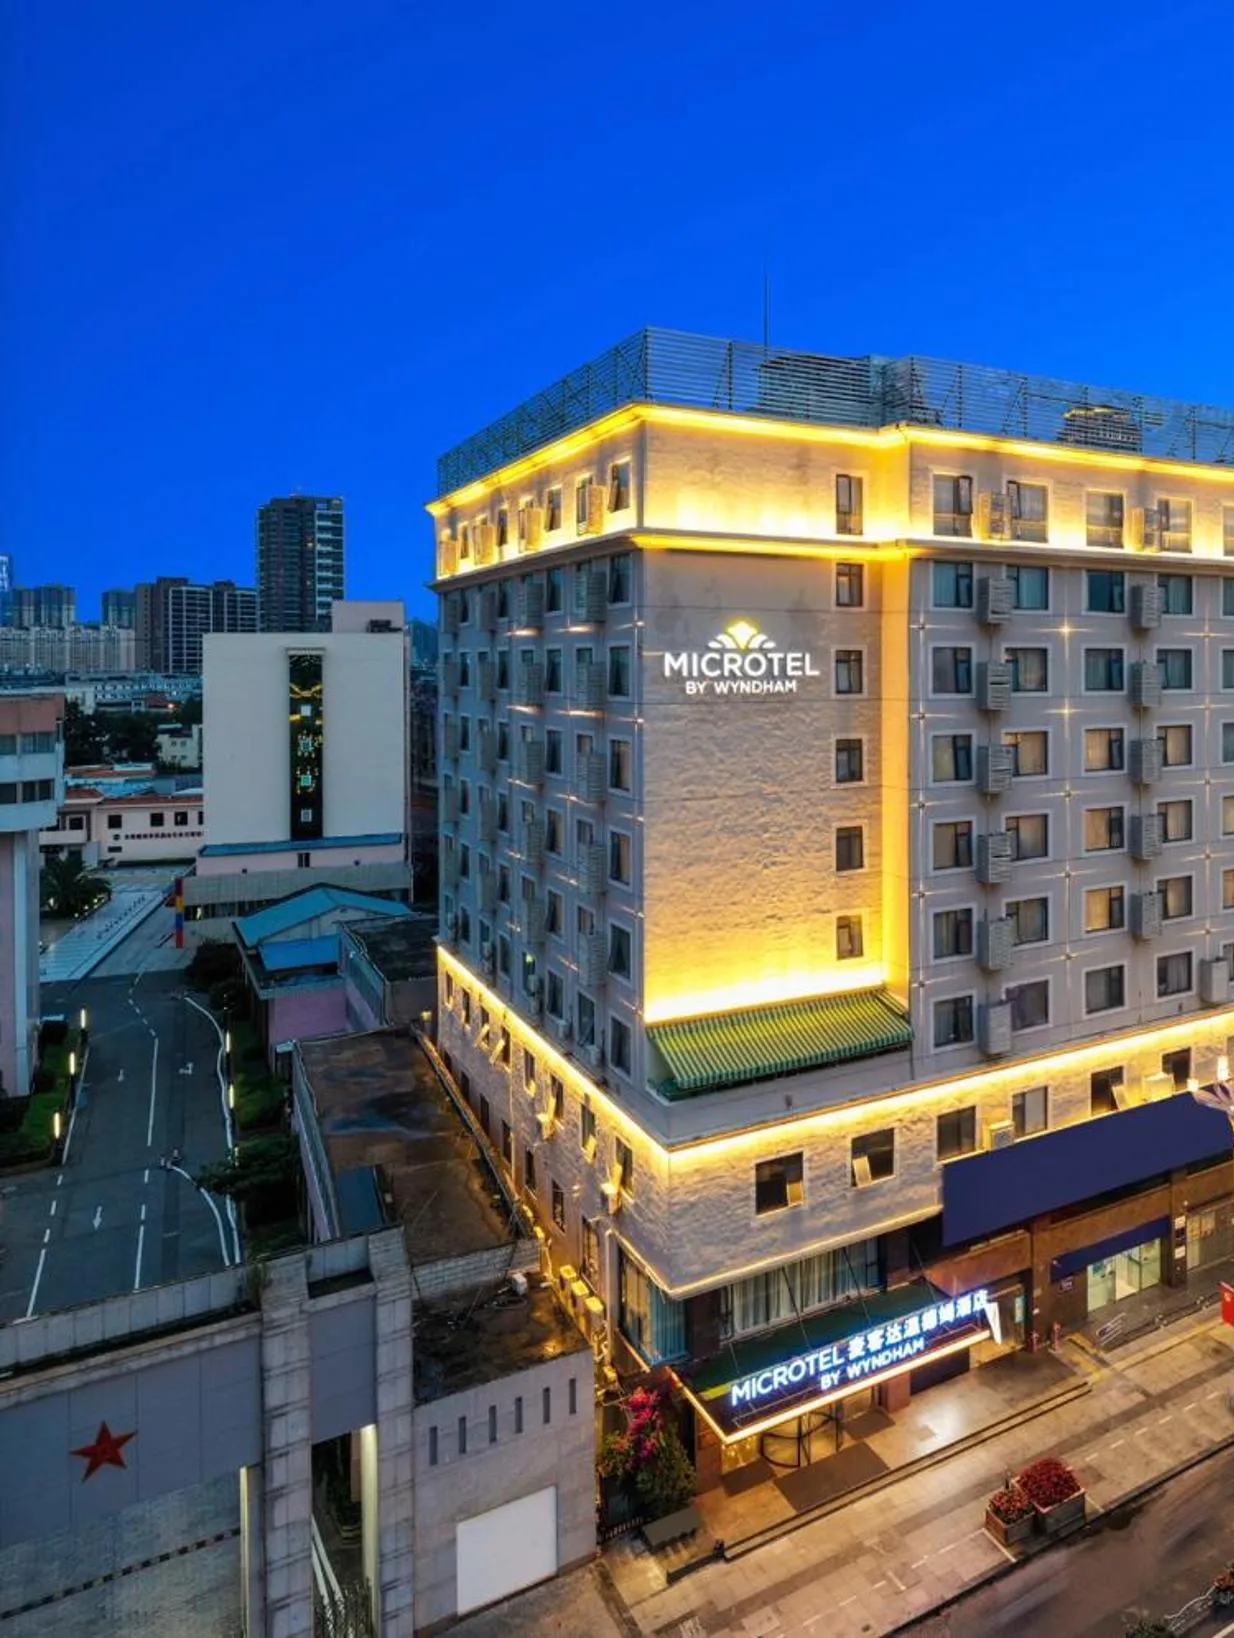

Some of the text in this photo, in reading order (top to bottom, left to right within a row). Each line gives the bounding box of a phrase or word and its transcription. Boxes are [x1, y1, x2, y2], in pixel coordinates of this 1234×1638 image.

[664, 652, 819, 677] MICROTEL
[685, 680, 797, 695] BY WYNDHAM
[731, 1346, 845, 1406] MICROTEL
[819, 1339, 926, 1391] BY WYNDHAM
